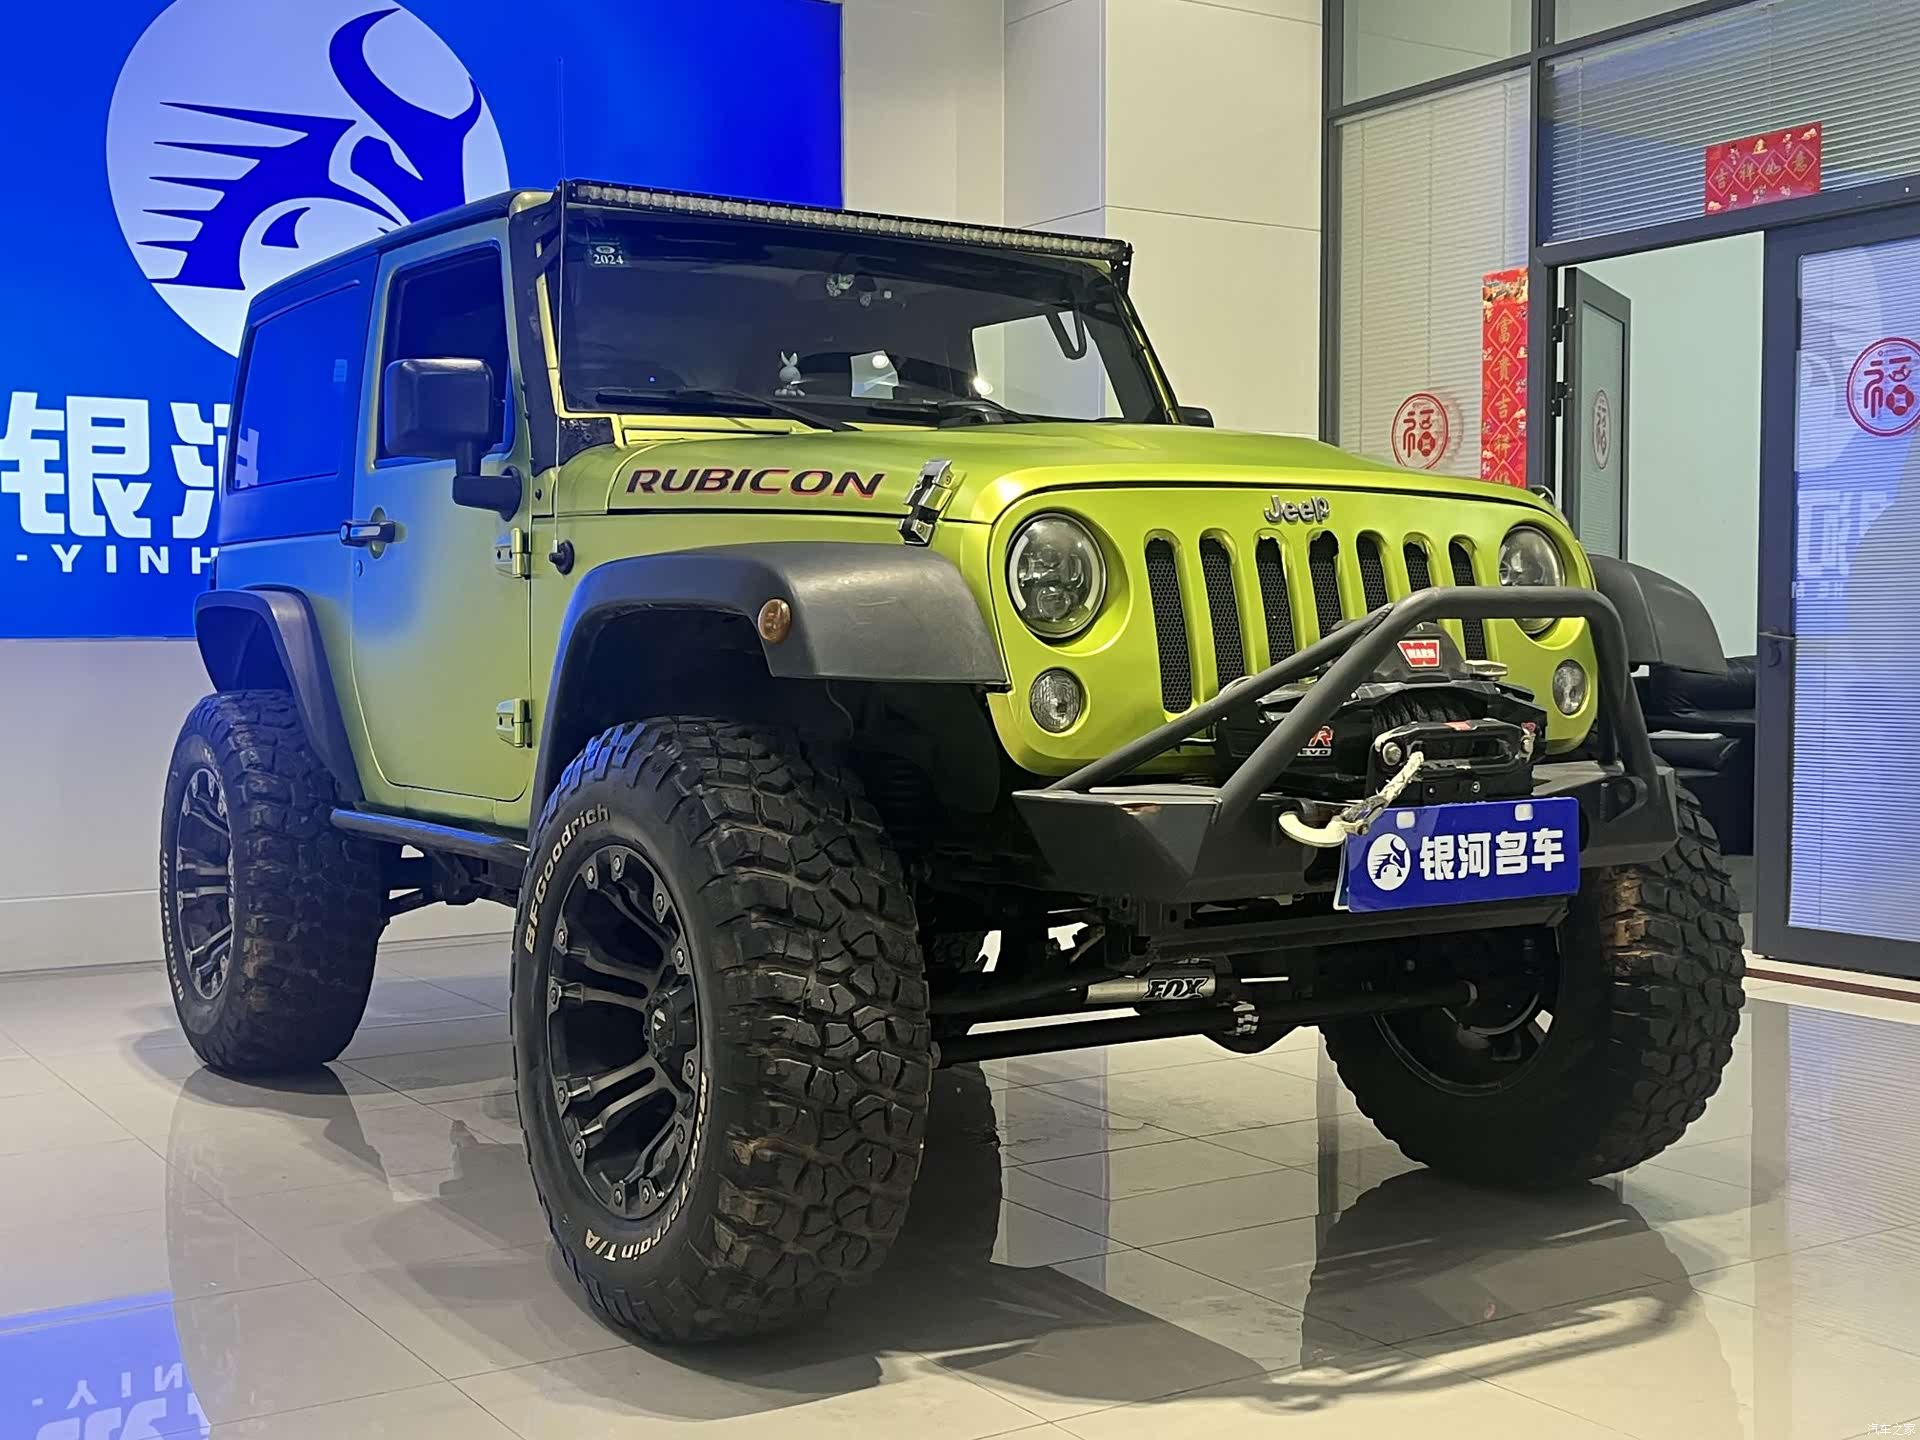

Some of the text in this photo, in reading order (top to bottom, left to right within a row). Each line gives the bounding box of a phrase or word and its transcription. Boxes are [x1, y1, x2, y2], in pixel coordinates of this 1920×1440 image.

[593, 254, 624, 265] 2024
[626, 467, 886, 498] RUBICON
[1264, 494, 1329, 525] Jeep
[1299, 747, 1331, 757] EVO
[1420, 828, 1565, 881] 银河名车
[525, 804, 610, 954] BFGoodrich
[1145, 977, 1207, 999] FOX
